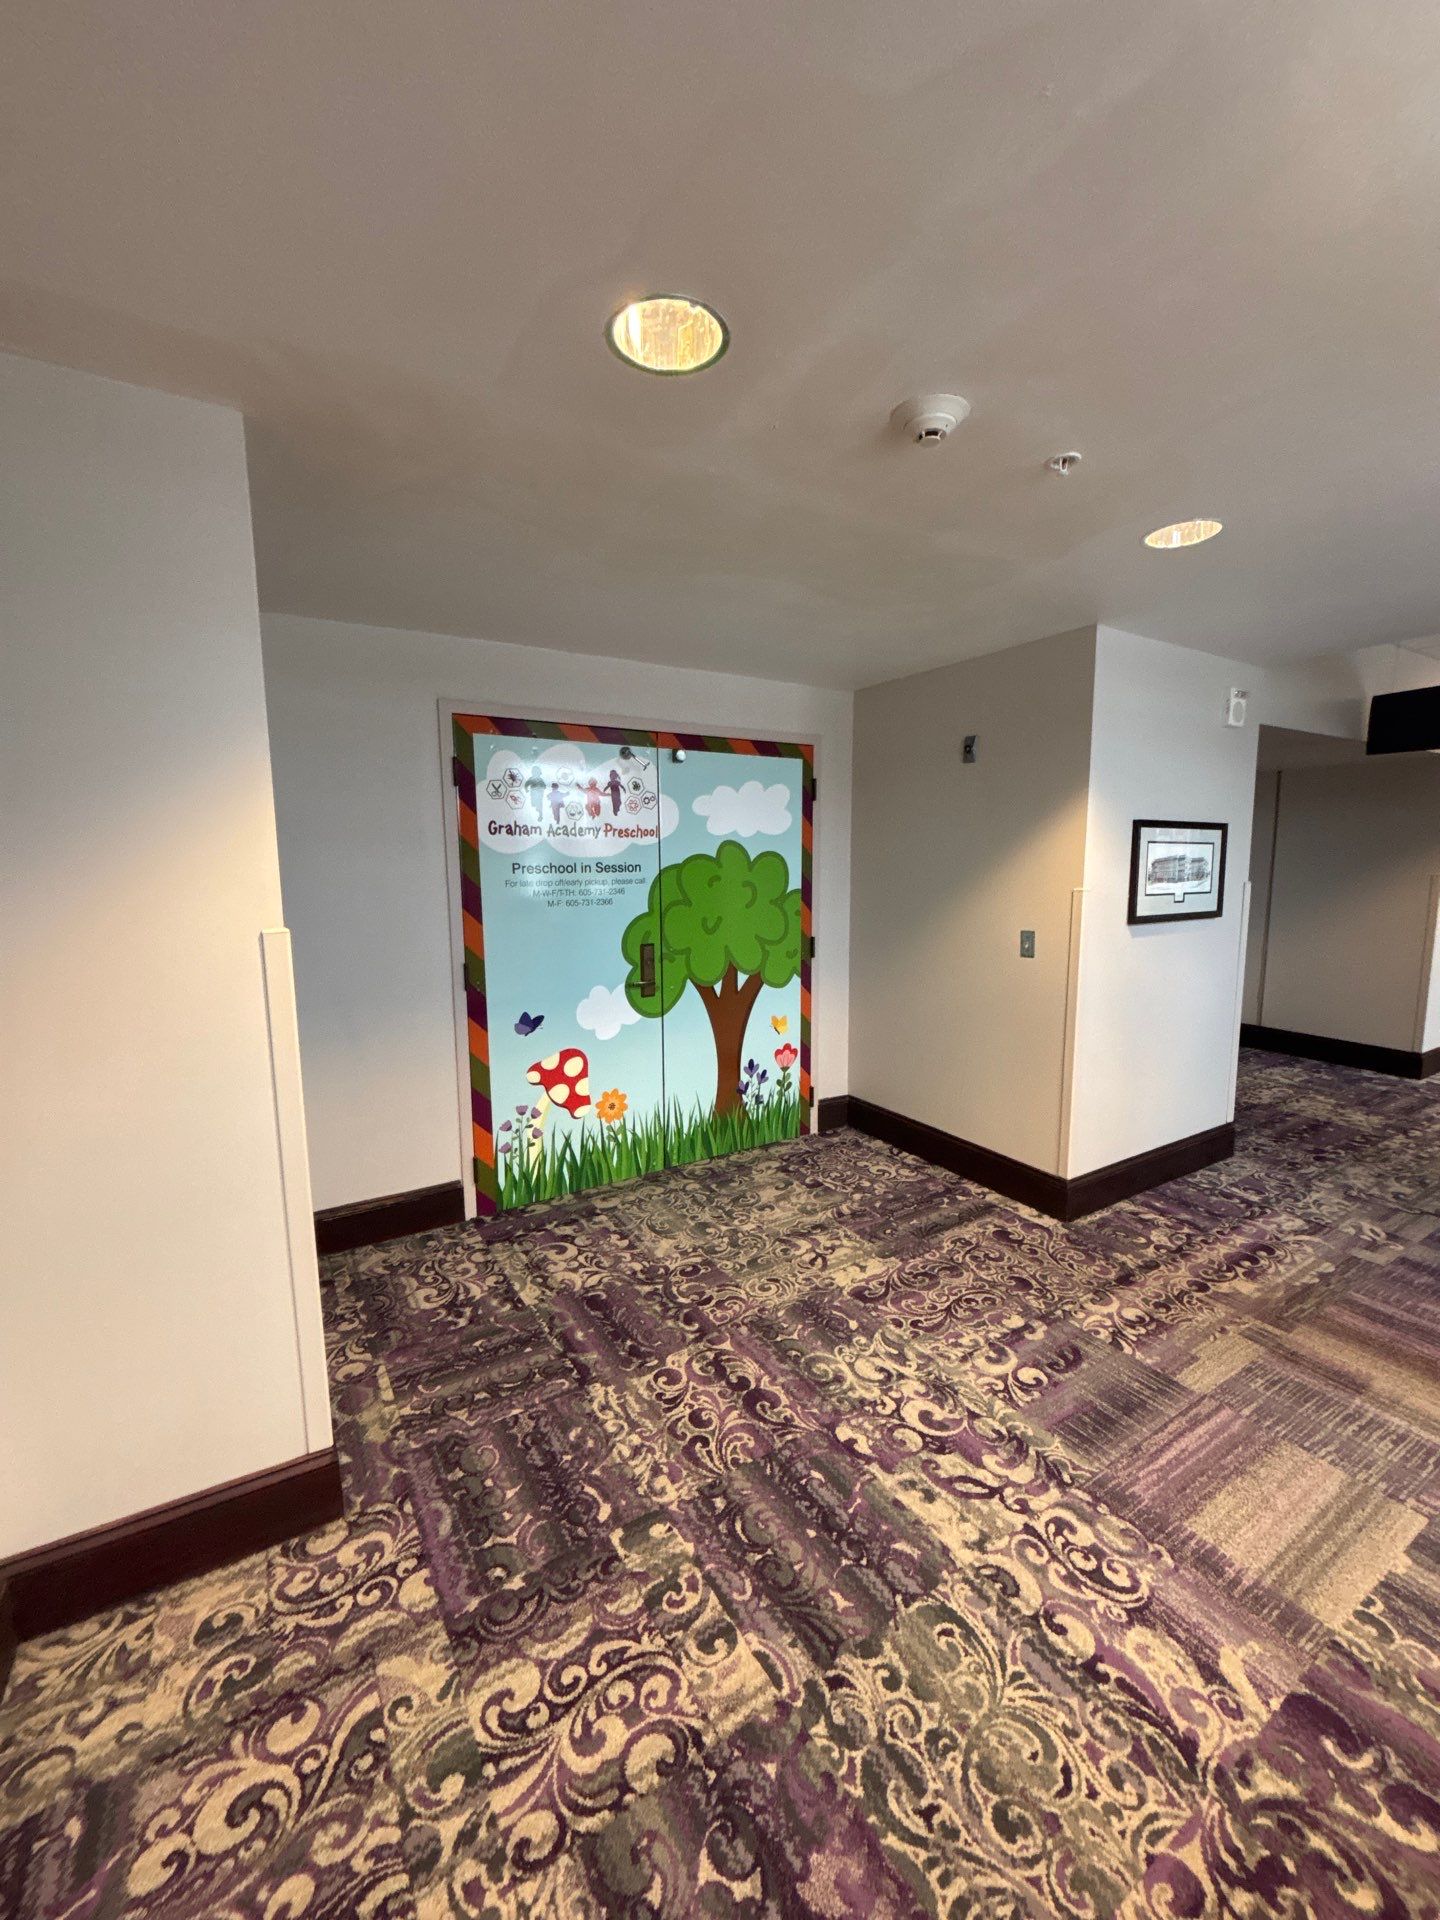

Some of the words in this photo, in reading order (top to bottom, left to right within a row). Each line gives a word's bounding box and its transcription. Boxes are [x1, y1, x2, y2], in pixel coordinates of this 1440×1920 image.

[488, 820, 542, 836] Graham
[547, 822, 600, 839] Academy
[603, 822, 658, 838] Preschool
[512, 862, 577, 874] Preschool
[581, 862, 591, 873] in
[595, 862, 641, 873] Session
